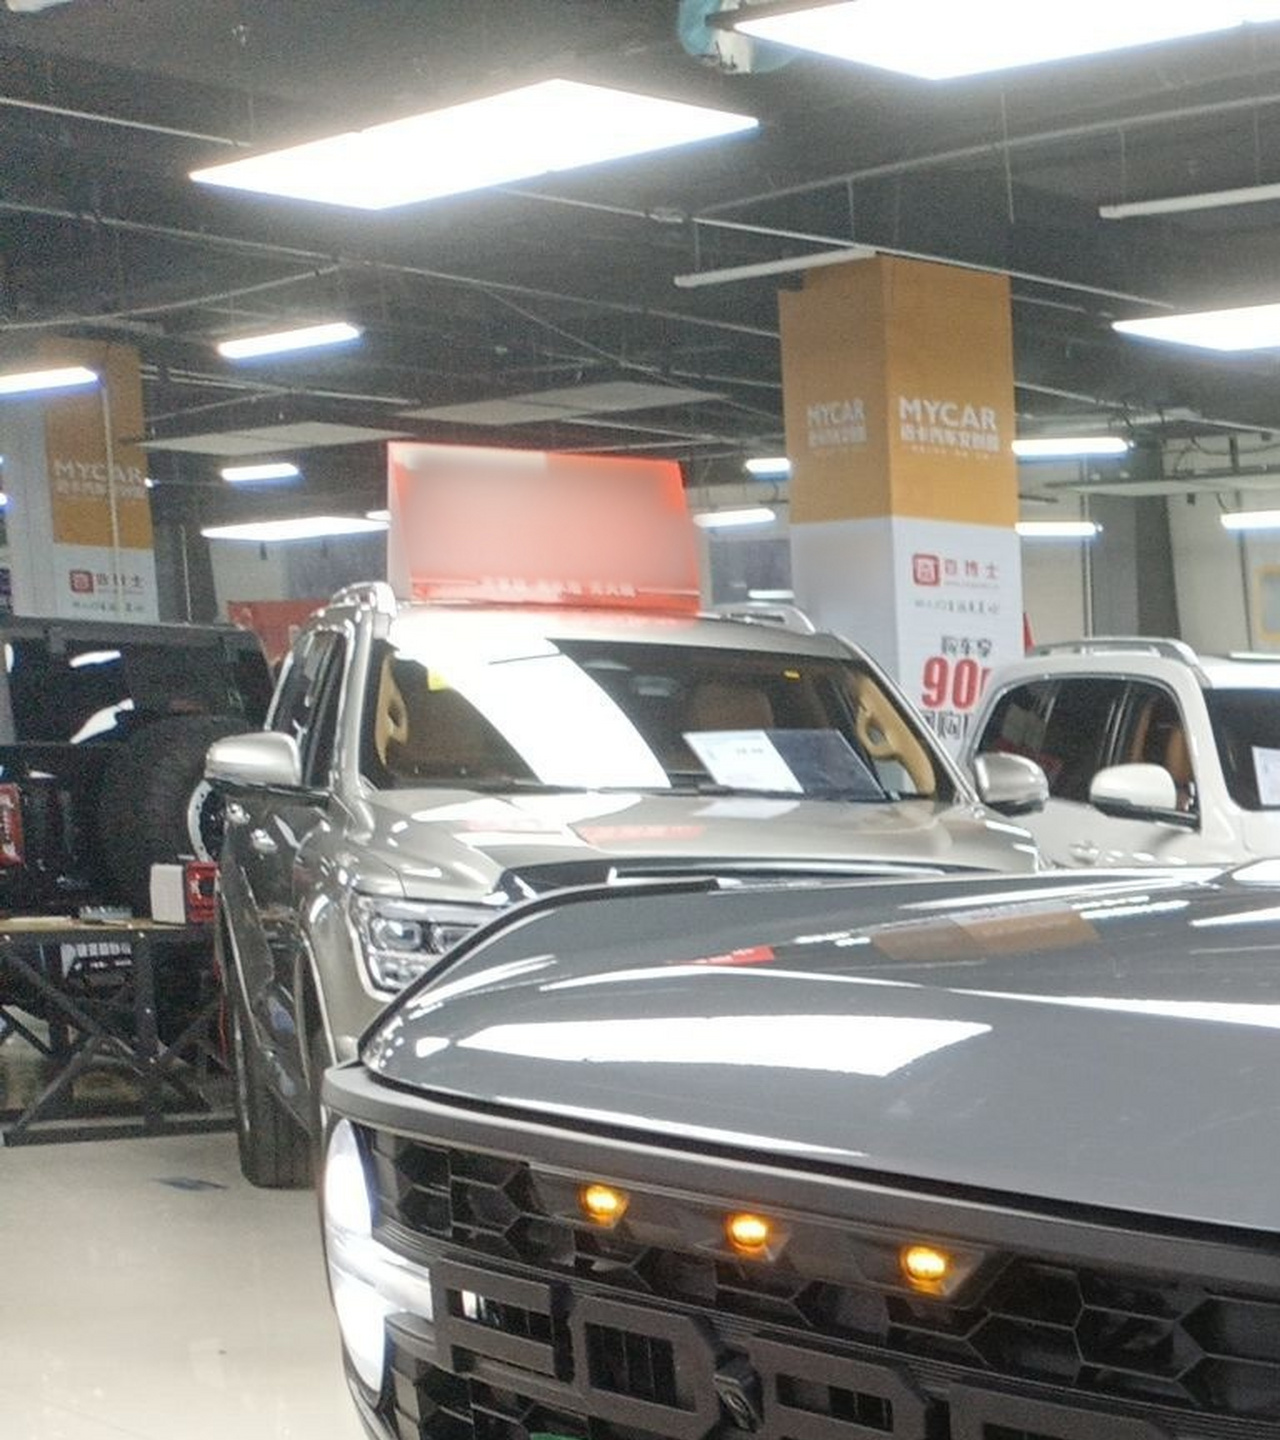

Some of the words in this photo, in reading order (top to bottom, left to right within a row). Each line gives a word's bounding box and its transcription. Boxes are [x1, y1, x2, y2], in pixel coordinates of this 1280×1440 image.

[807, 398, 866, 427] MYCAR
[899, 396, 997, 431] MYCAR
[54, 460, 144, 486] MYCAR
